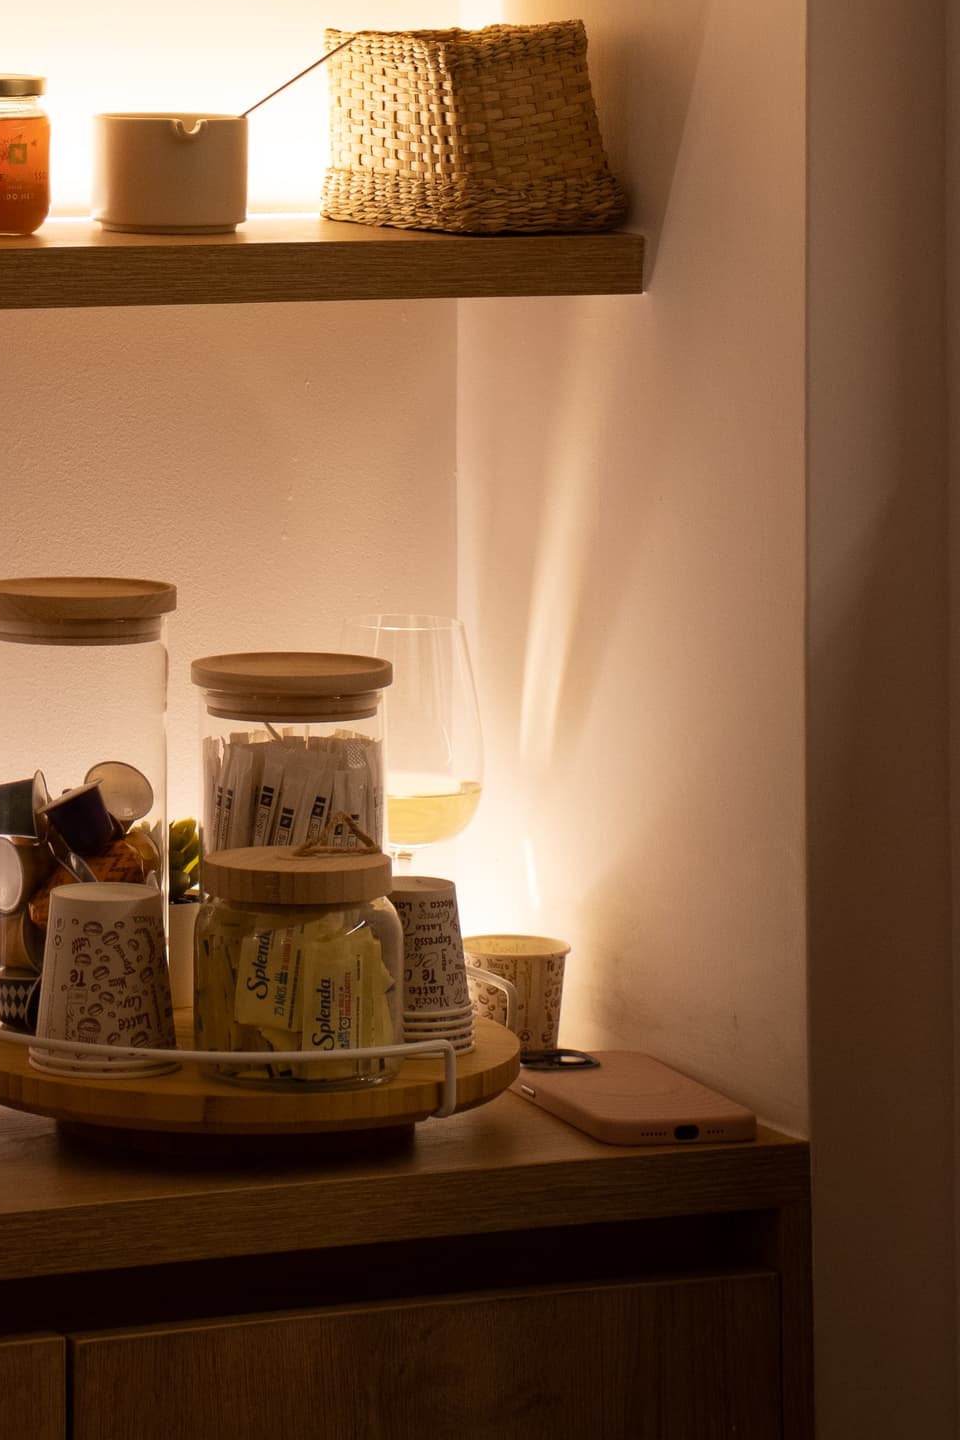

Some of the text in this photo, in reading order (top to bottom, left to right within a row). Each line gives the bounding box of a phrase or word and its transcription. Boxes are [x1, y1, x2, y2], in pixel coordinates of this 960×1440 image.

[414, 933, 451, 946] Expresso
[407, 985, 445, 996] Latte
[311, 977, 335, 1051] Splenda
